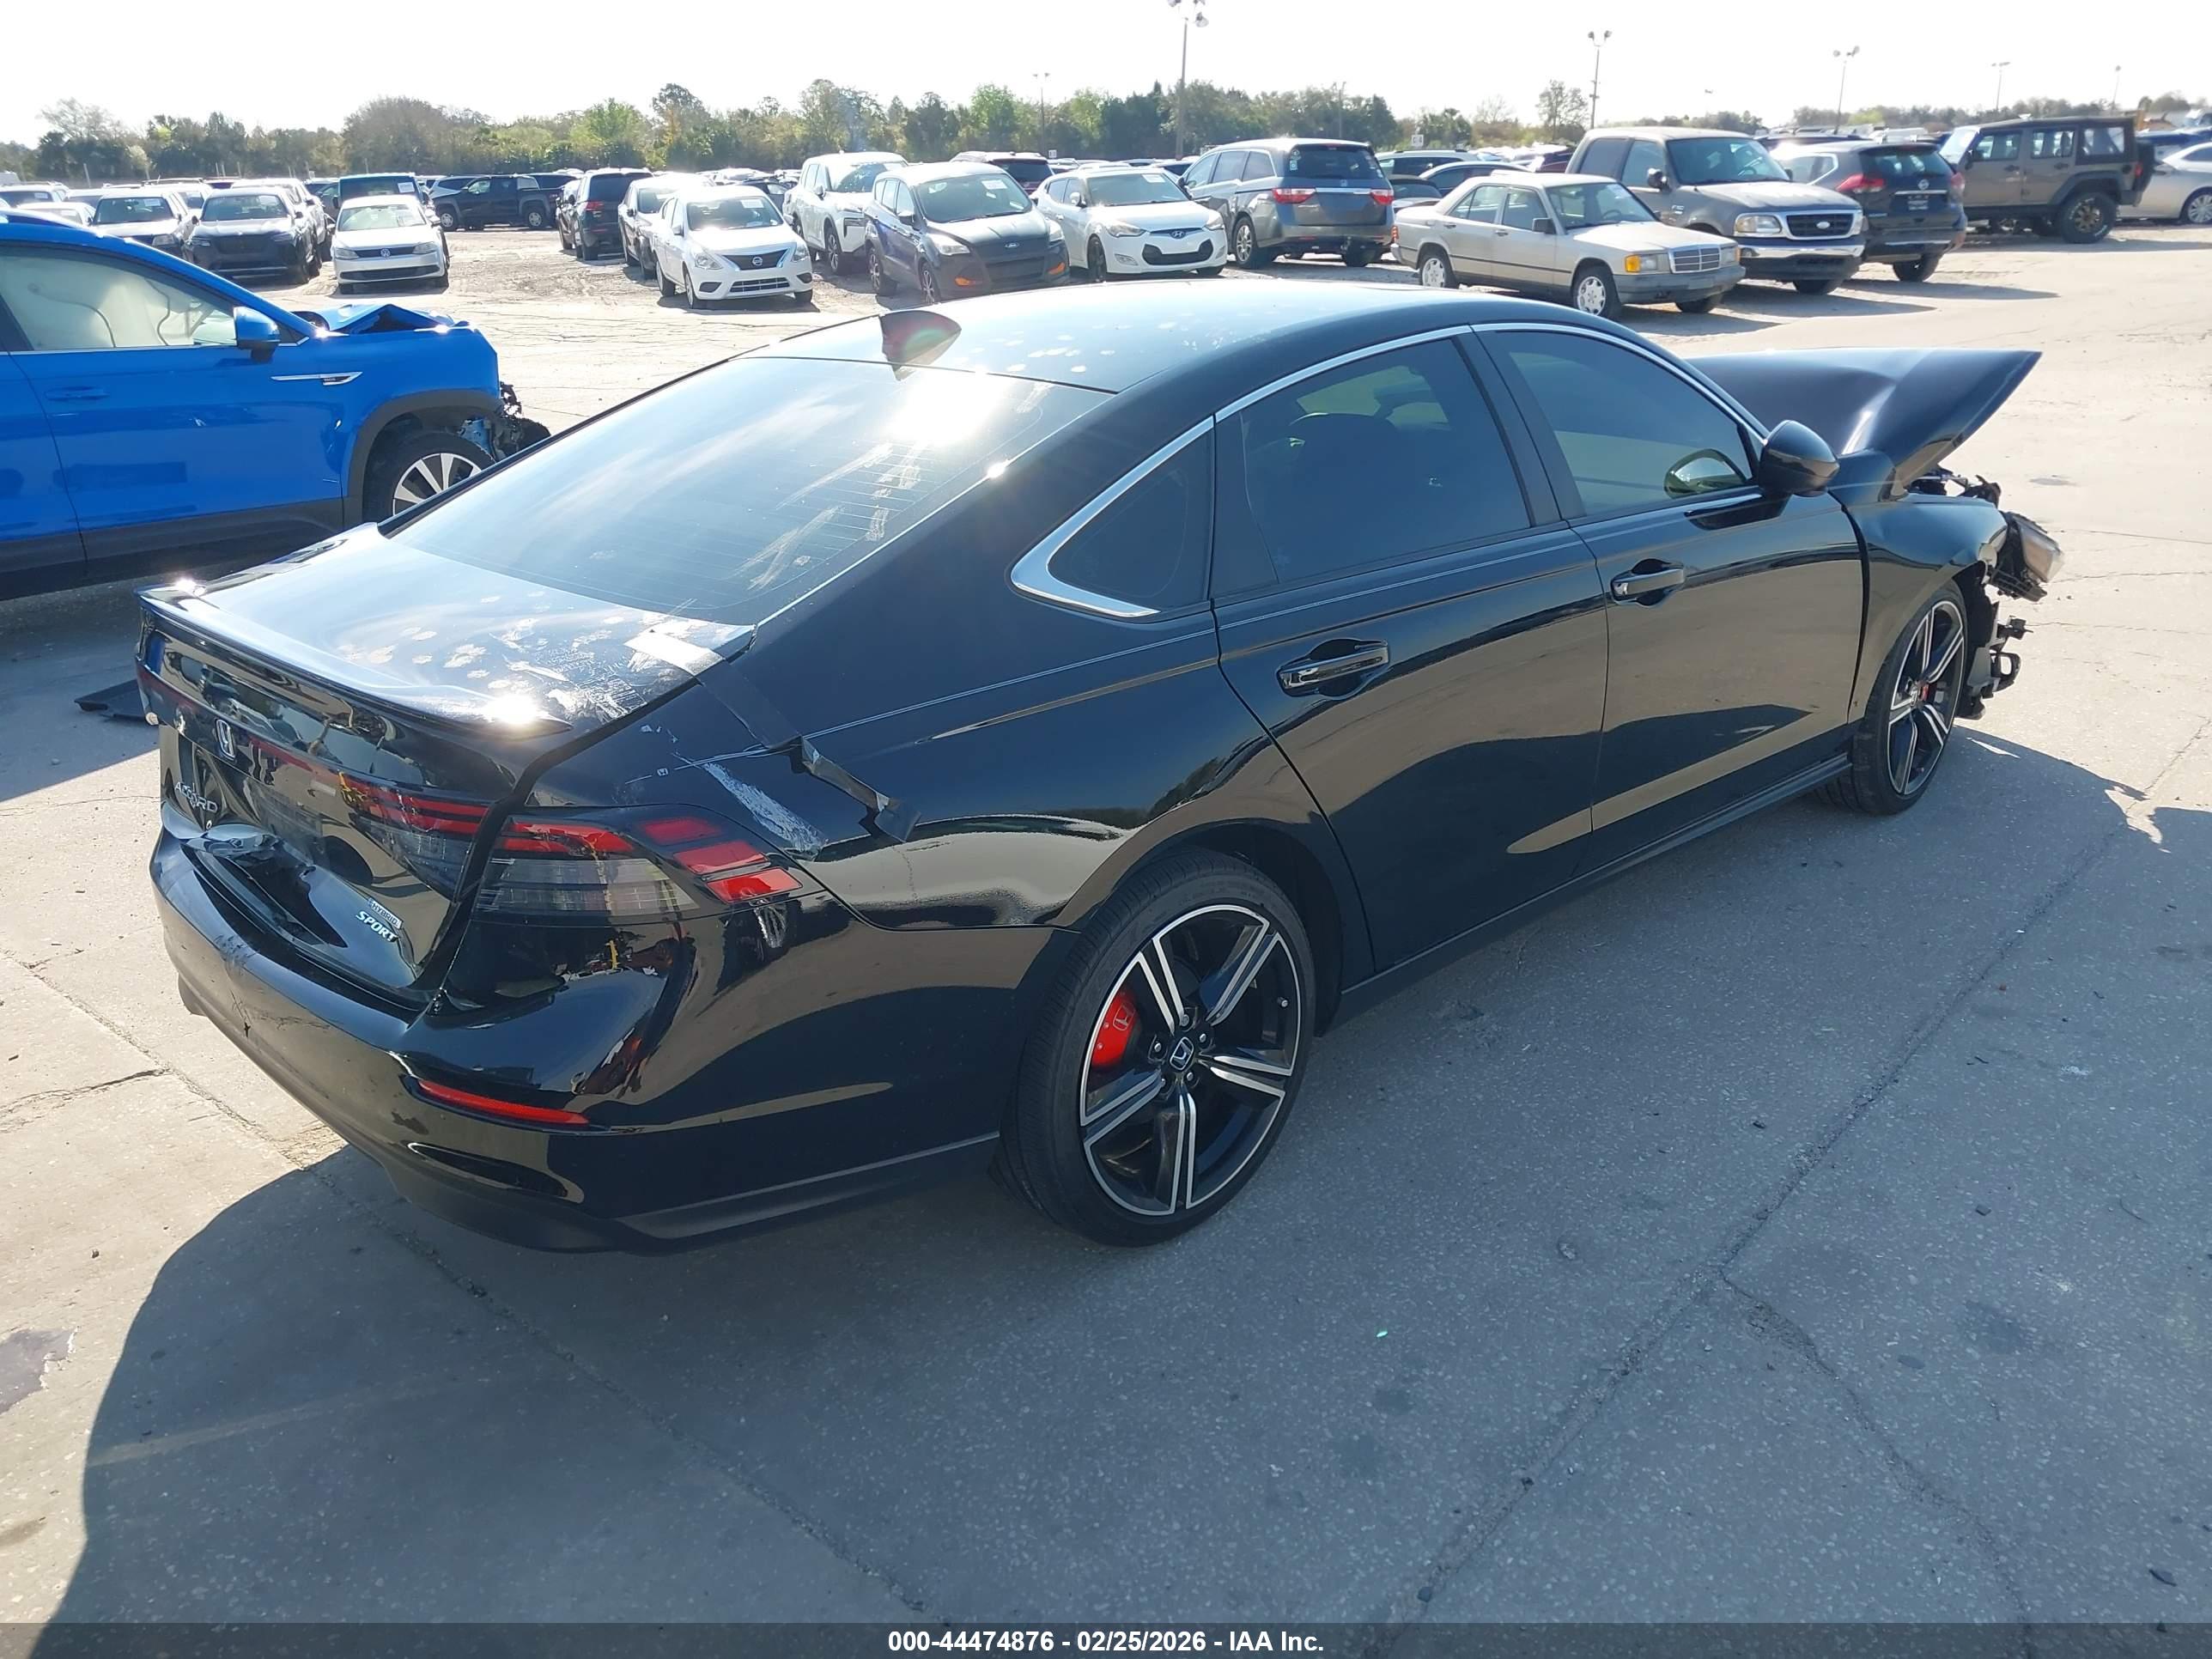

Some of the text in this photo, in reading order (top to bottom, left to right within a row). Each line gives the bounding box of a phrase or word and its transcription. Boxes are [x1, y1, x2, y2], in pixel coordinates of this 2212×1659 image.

[174, 781, 218, 813] ACCORD
[356, 910, 398, 942] SPORT
[371, 902, 398, 925] HYBRID
